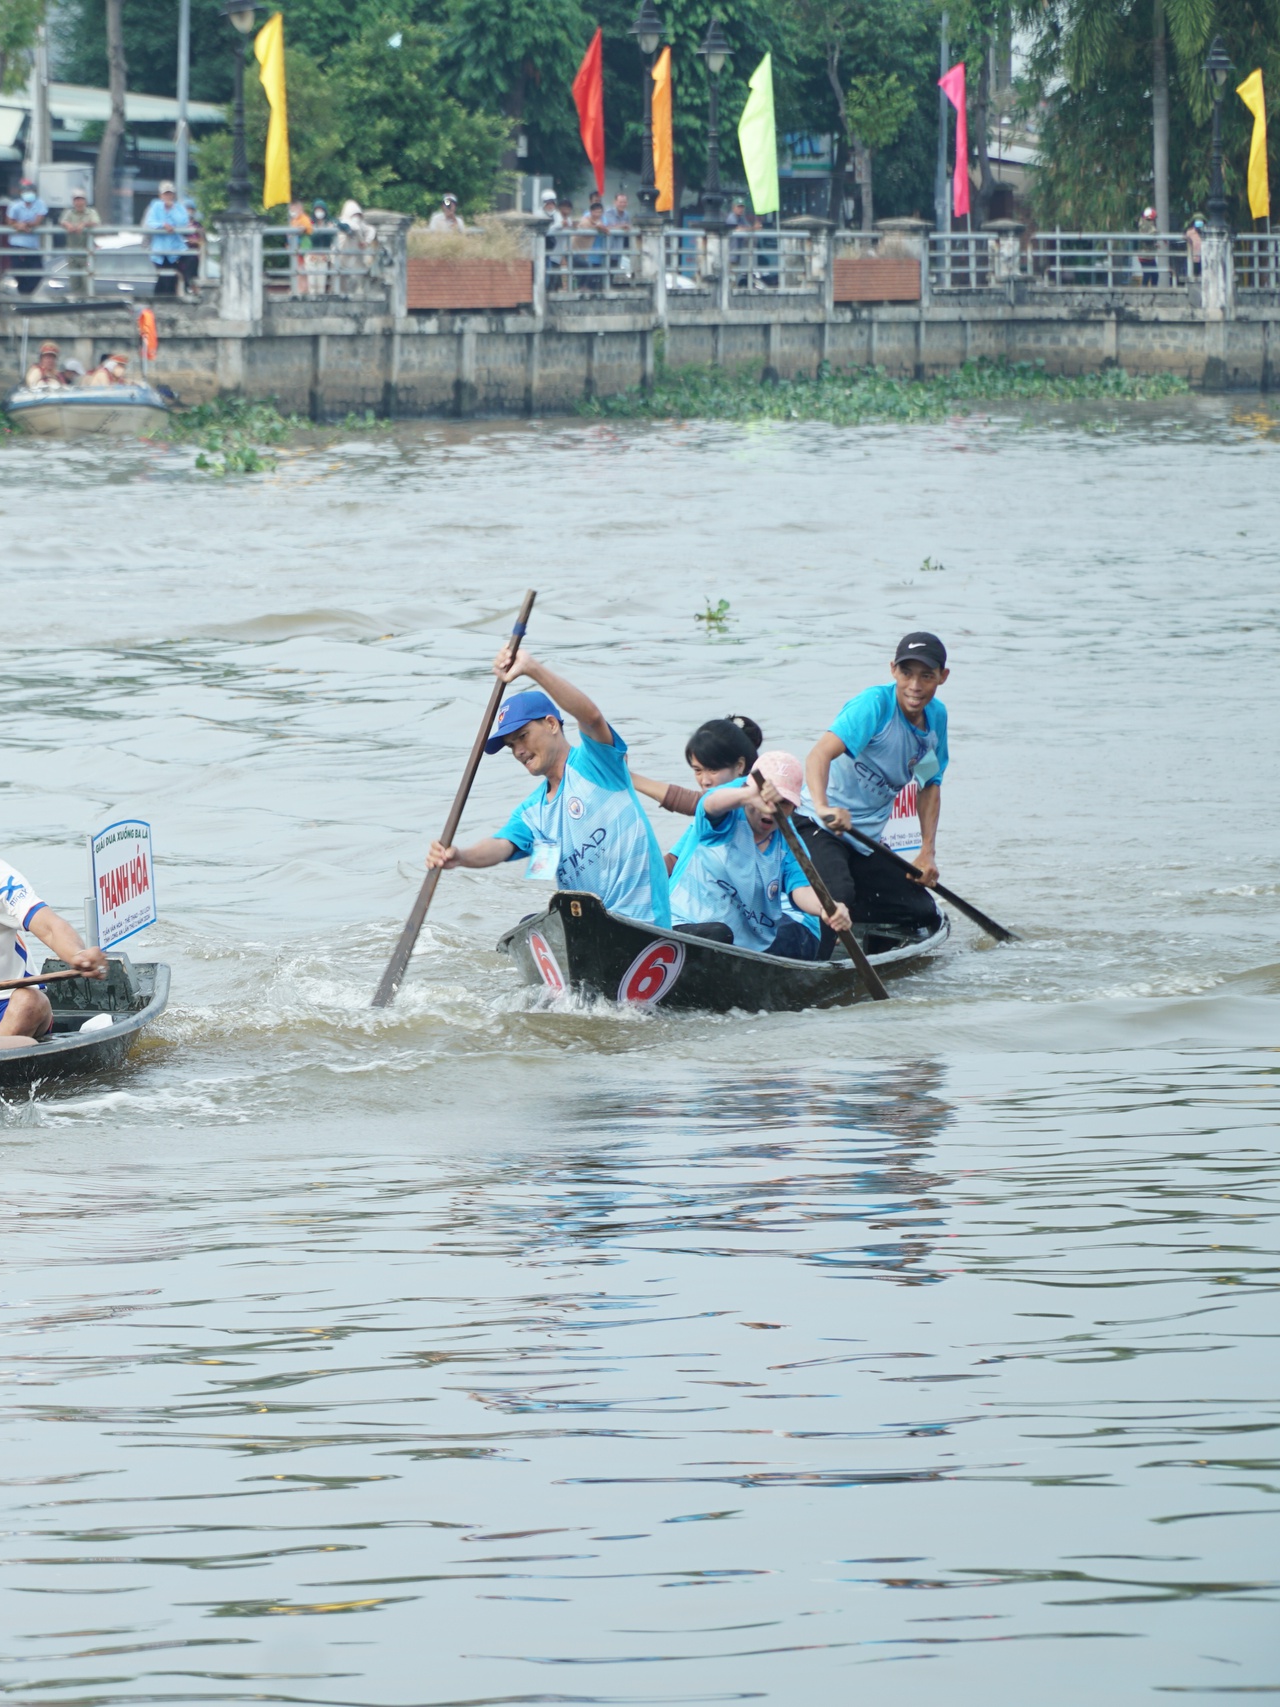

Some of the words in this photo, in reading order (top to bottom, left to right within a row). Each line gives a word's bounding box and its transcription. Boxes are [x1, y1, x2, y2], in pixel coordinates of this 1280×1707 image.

[135, 828, 142, 839] BA
[142, 827, 149, 839] LÁ
[99, 861, 130, 919] THẠNH
[130, 844, 150, 899] HÓA
[531, 933, 564, 990] 6
[626, 944, 678, 1004] 6
